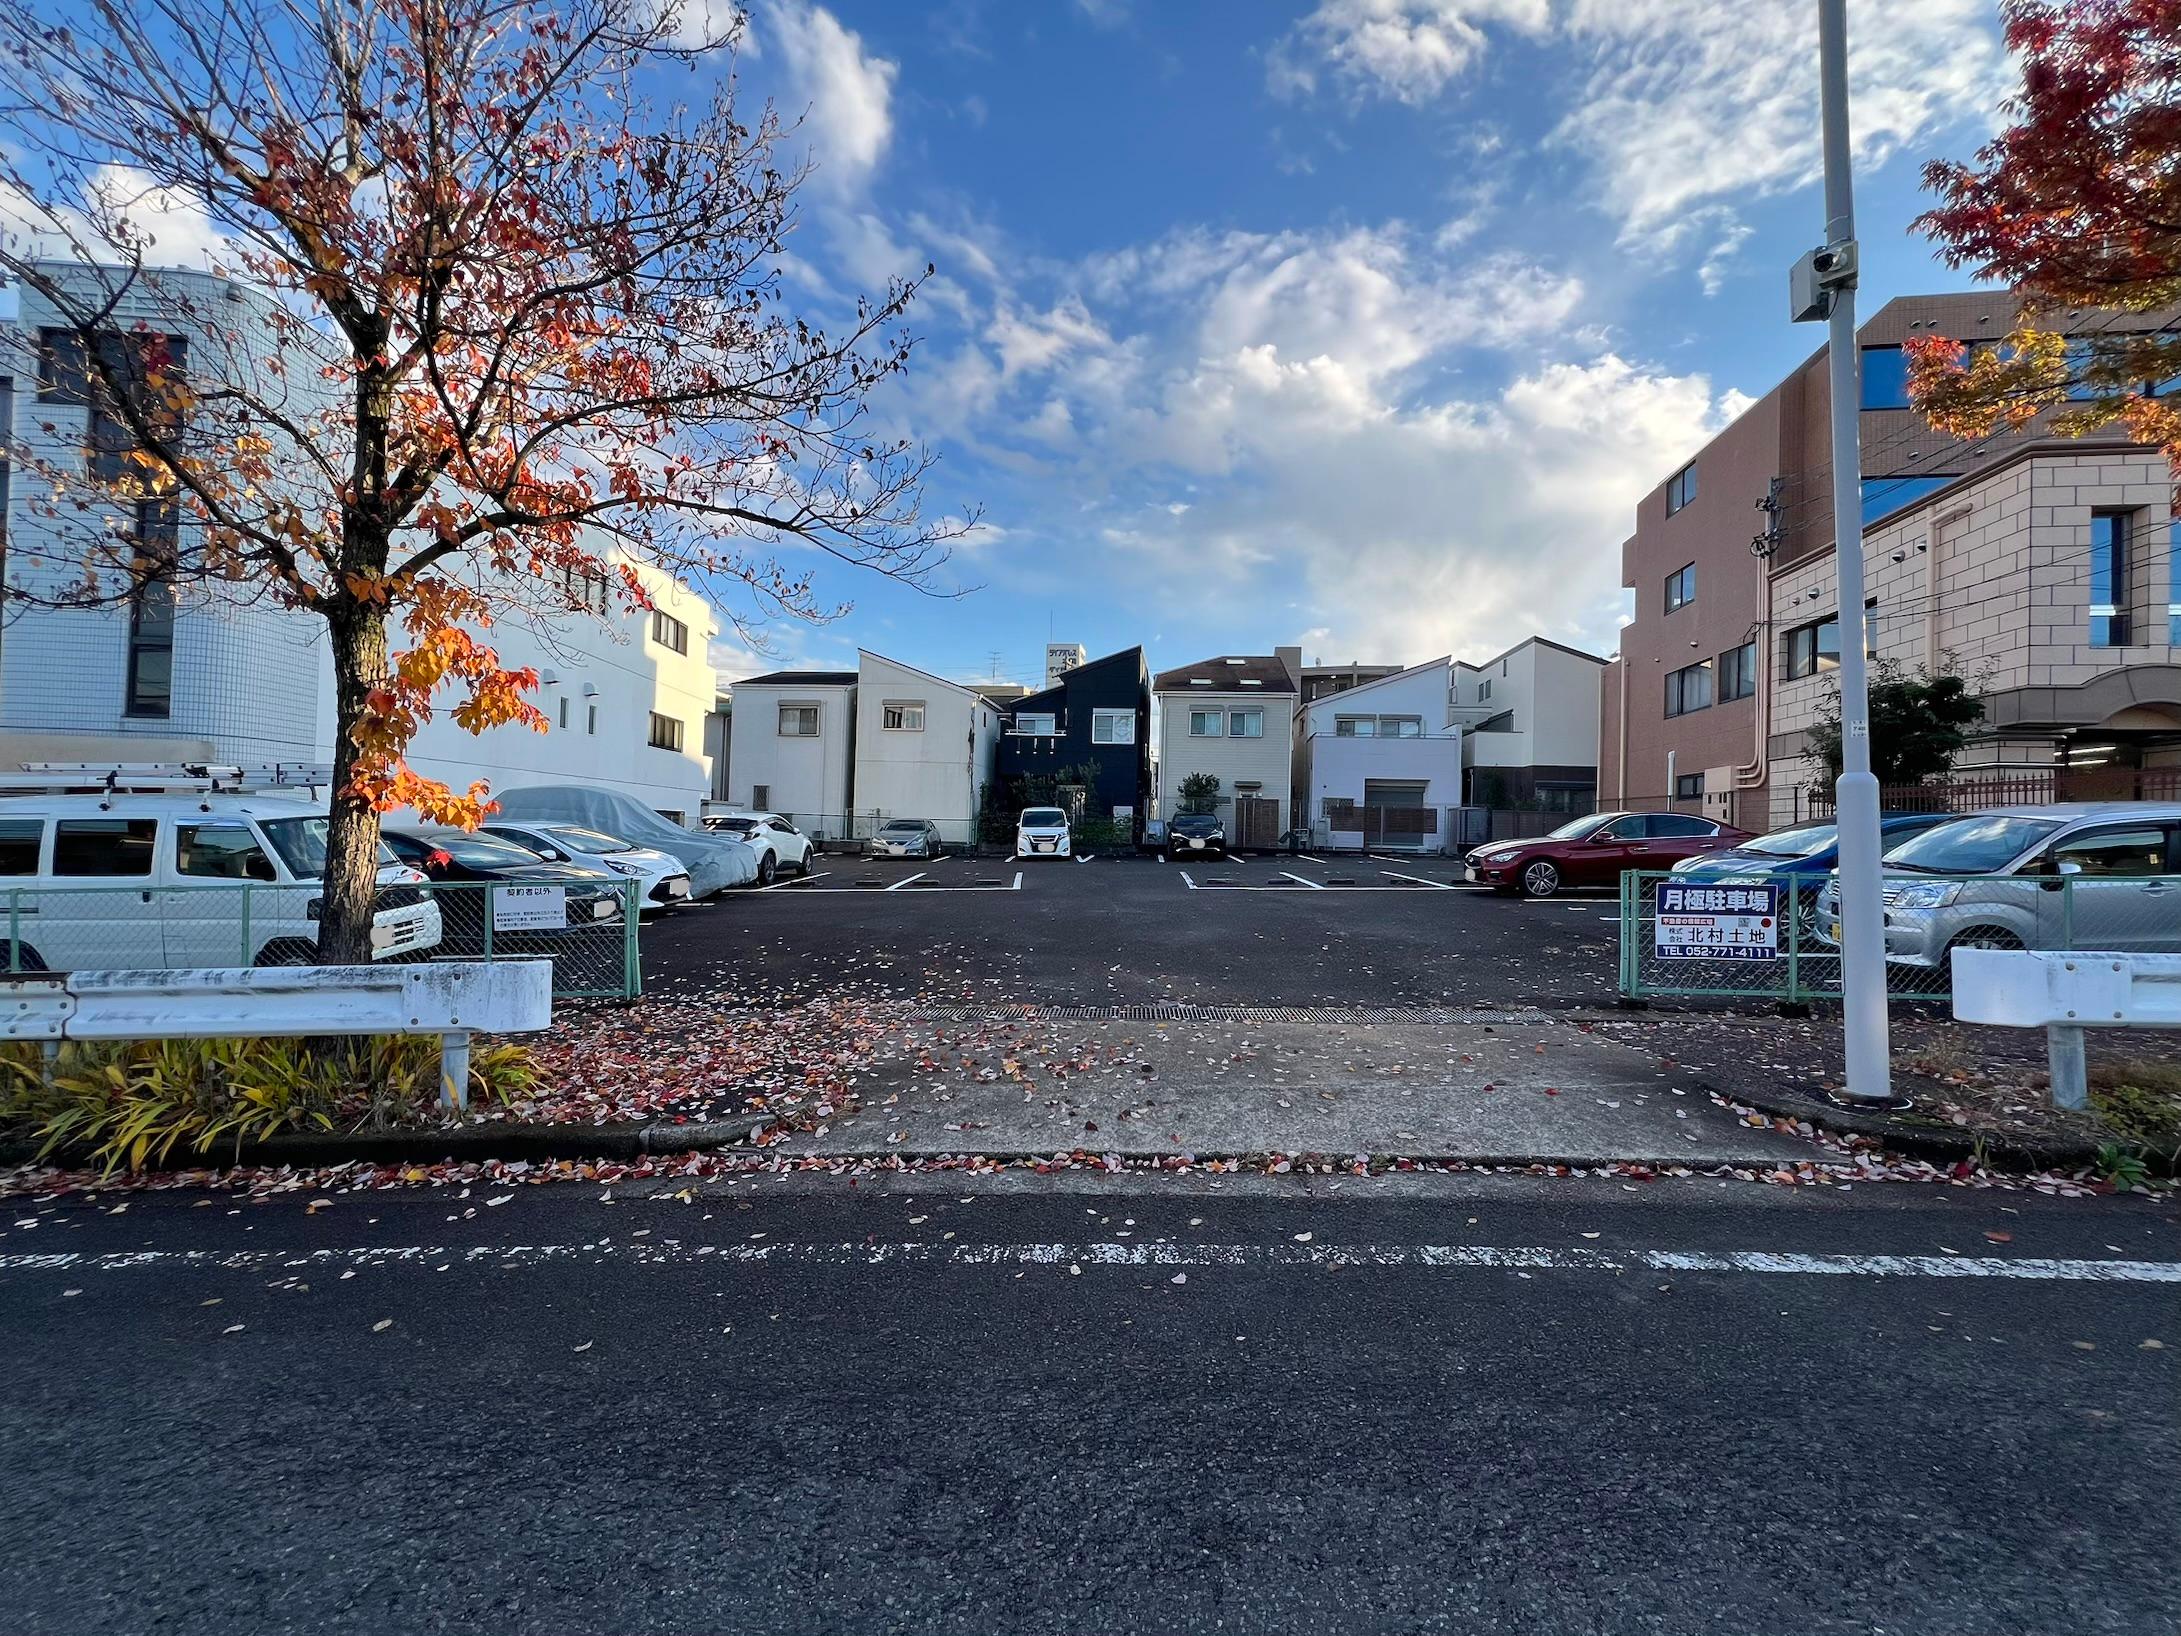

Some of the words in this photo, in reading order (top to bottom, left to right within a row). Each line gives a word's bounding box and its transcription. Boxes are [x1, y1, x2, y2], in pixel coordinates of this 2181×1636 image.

[506, 888, 552, 896] 契約者以外
[1664, 889, 1770, 912] 月極駐車場
[1687, 927, 1766, 944] 北村土地
[1663, 946, 1683, 956] TEL
[1686, 946, 1770, 958] 052-771-4111
